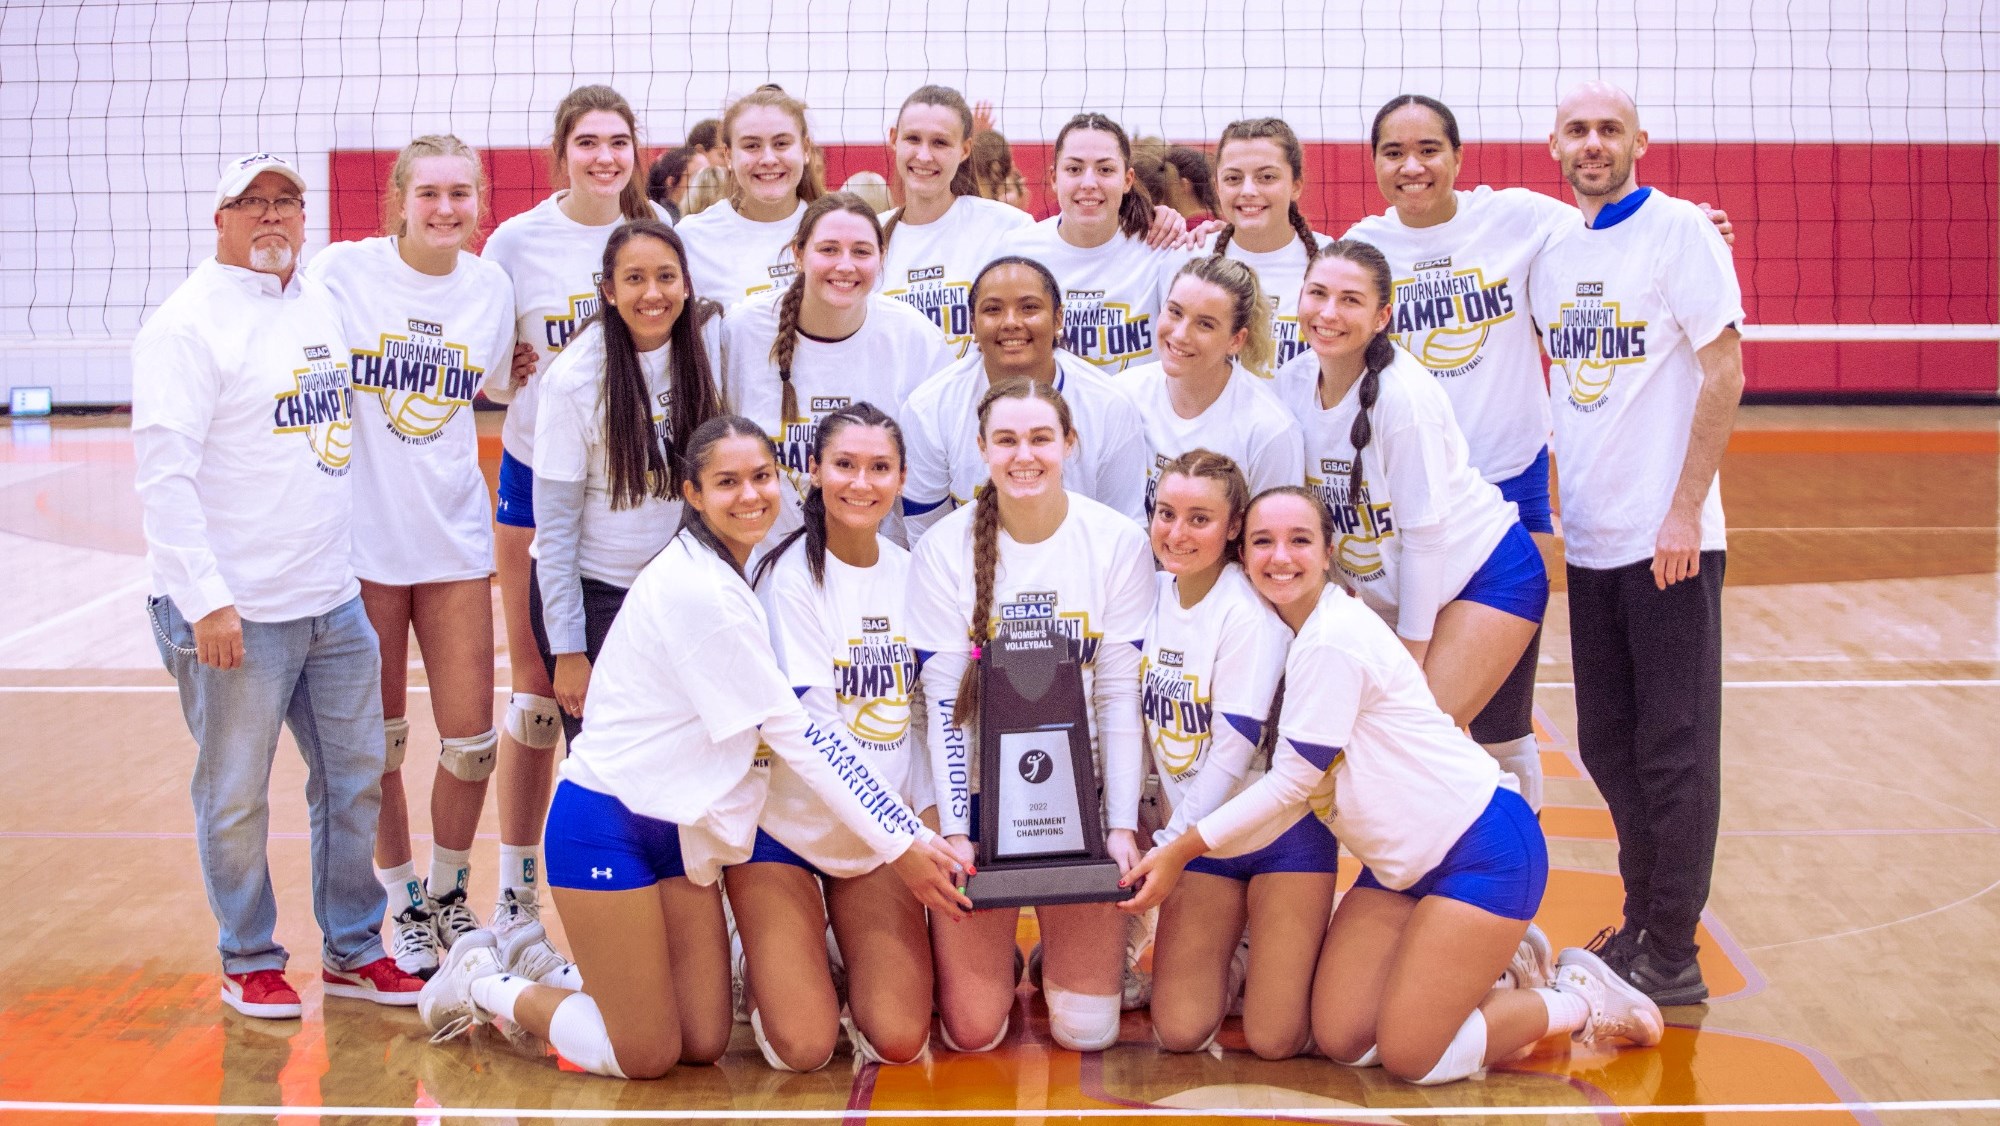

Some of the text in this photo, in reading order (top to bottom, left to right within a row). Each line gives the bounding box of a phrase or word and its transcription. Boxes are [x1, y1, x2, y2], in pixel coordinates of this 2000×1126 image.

[910, 267, 943, 281] GSAC
[1417, 270, 1450, 281] 2022
[911, 281, 942, 292] 2022
[1397, 275, 1475, 303] TOURNAMENT
[1577, 284, 1602, 294] GSAC
[1068, 301, 1102, 309] 2022
[1577, 299, 1602, 308] 2022
[1064, 308, 1123, 326] RNAMENT
[1563, 309, 1614, 328] TOURNAMENT
[409, 320, 441, 335] GSAC
[411, 335, 442, 346] 2022
[306, 346, 330, 359] GSAC
[386, 340, 462, 368] TOURNAMENT
[299, 369, 350, 393] TOURNAMENT
[813, 399, 849, 409] GSAC
[1323, 461, 1351, 473] GSAC
[1326, 476, 1350, 486] 202
[1002, 603, 1053, 619] GSAC
[1010, 630, 1047, 640] WOMEN'S
[1005, 640, 1053, 650] VOLLEYBALL
[804, 722, 898, 834] WARRIORS
[1029, 802, 1048, 811] 2022
[1012, 816, 1067, 827] TOURNAMENT
[1017, 827, 1064, 837] CHAMPIONS
